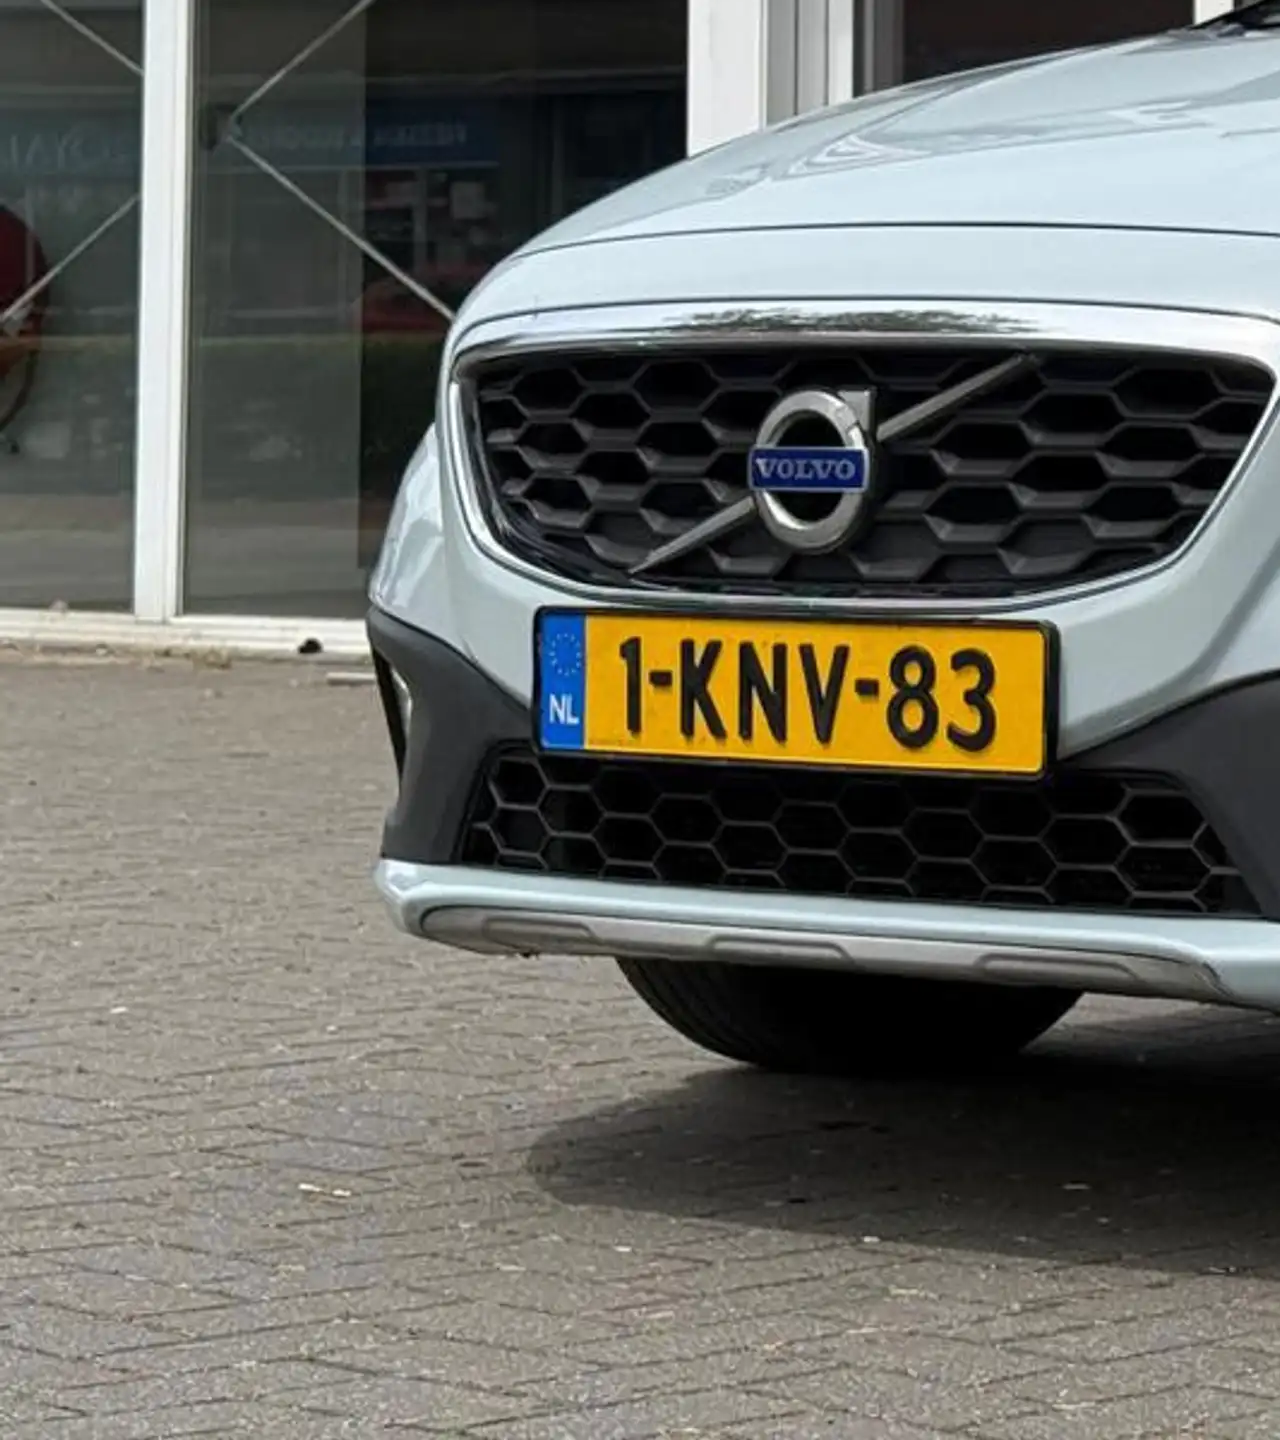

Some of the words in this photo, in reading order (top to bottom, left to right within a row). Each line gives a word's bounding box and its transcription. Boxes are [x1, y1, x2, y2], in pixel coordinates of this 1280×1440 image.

[755, 457, 857, 481] VOLVO
[548, 693, 579, 725] NL
[618, 635, 998, 753] 1-KNV-83
